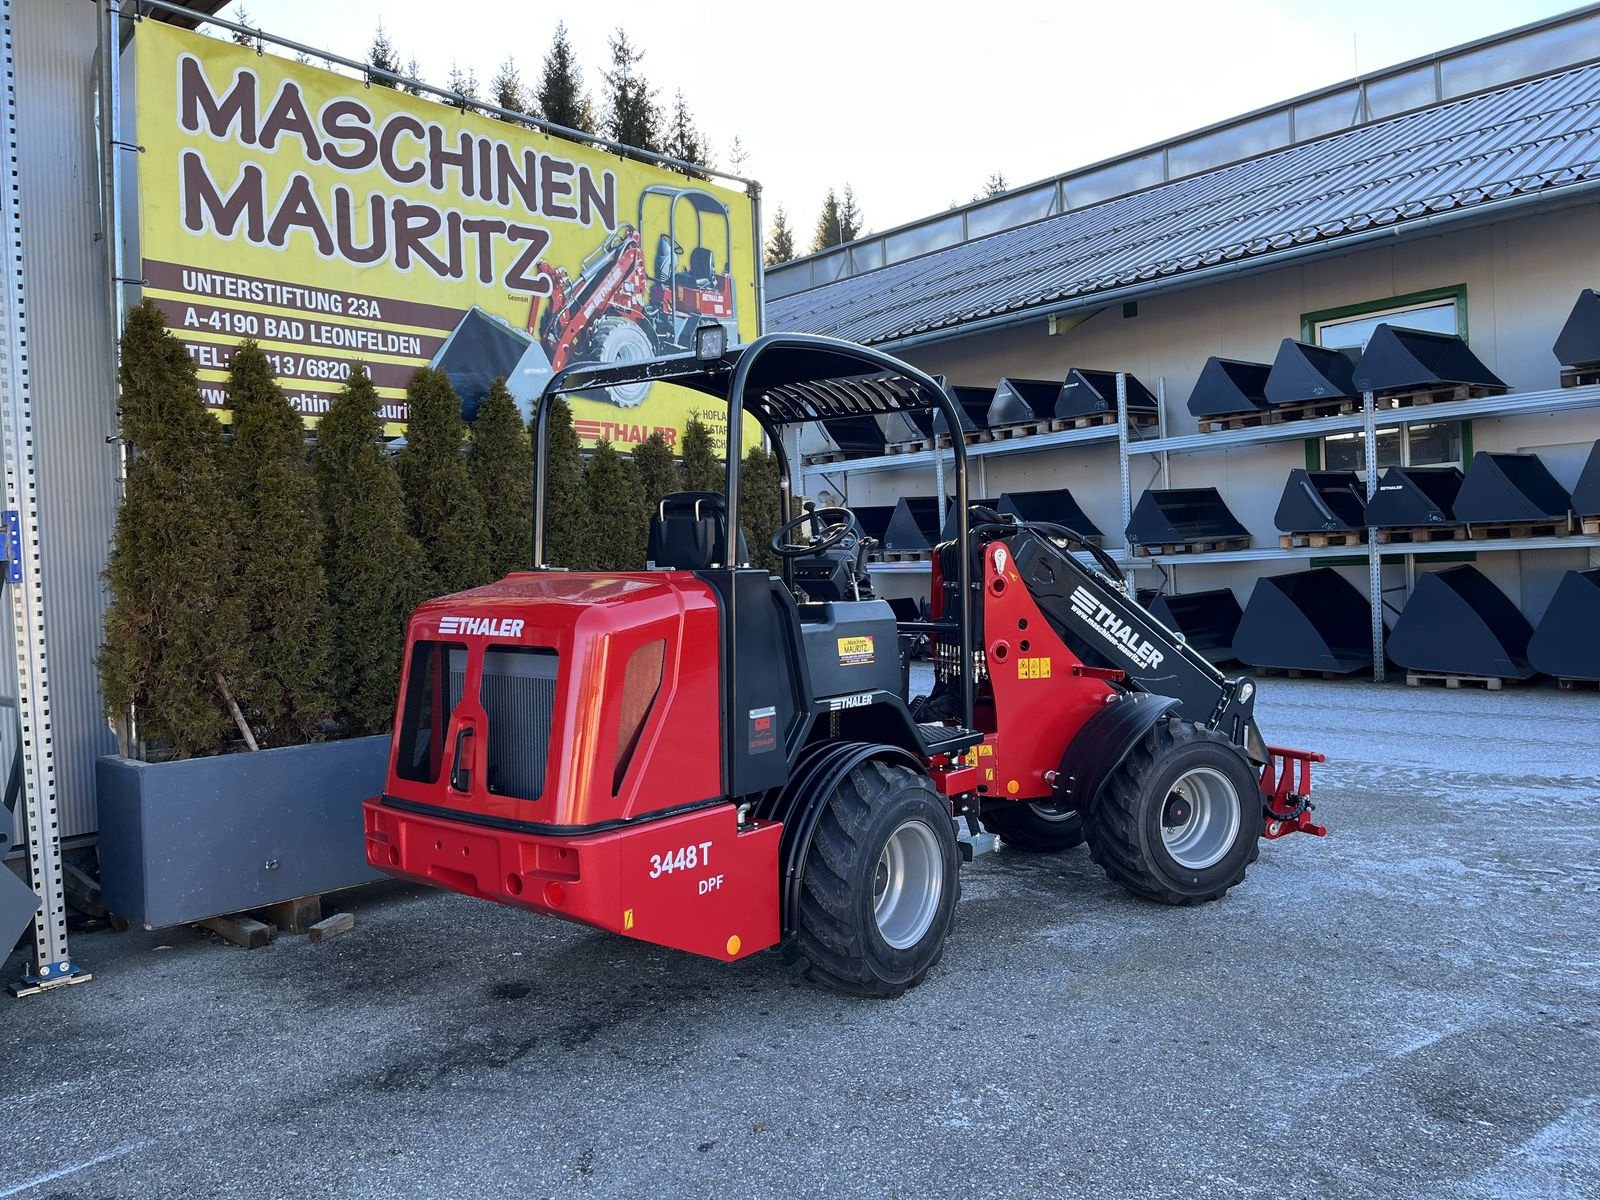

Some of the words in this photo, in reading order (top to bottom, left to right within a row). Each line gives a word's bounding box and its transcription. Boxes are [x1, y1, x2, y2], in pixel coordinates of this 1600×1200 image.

[182, 56, 615, 231] MASCHINEN
[184, 152, 550, 294] MAURITZ
[182, 270, 343, 313] UNTERSTIFTUNG
[347, 297, 382, 319] 23A
[184, 307, 259, 335] A-4190
[264, 318, 305, 341] BAD
[311, 324, 421, 355] LEONFELDEN
[185, 344, 229, 368] TEL:
[458, 617, 525, 637] THALER
[1094, 603, 1164, 670] THALER
[844, 644, 868, 653] MAURITZ
[841, 694, 873, 709] THALER
[698, 874, 724, 895] DPF
